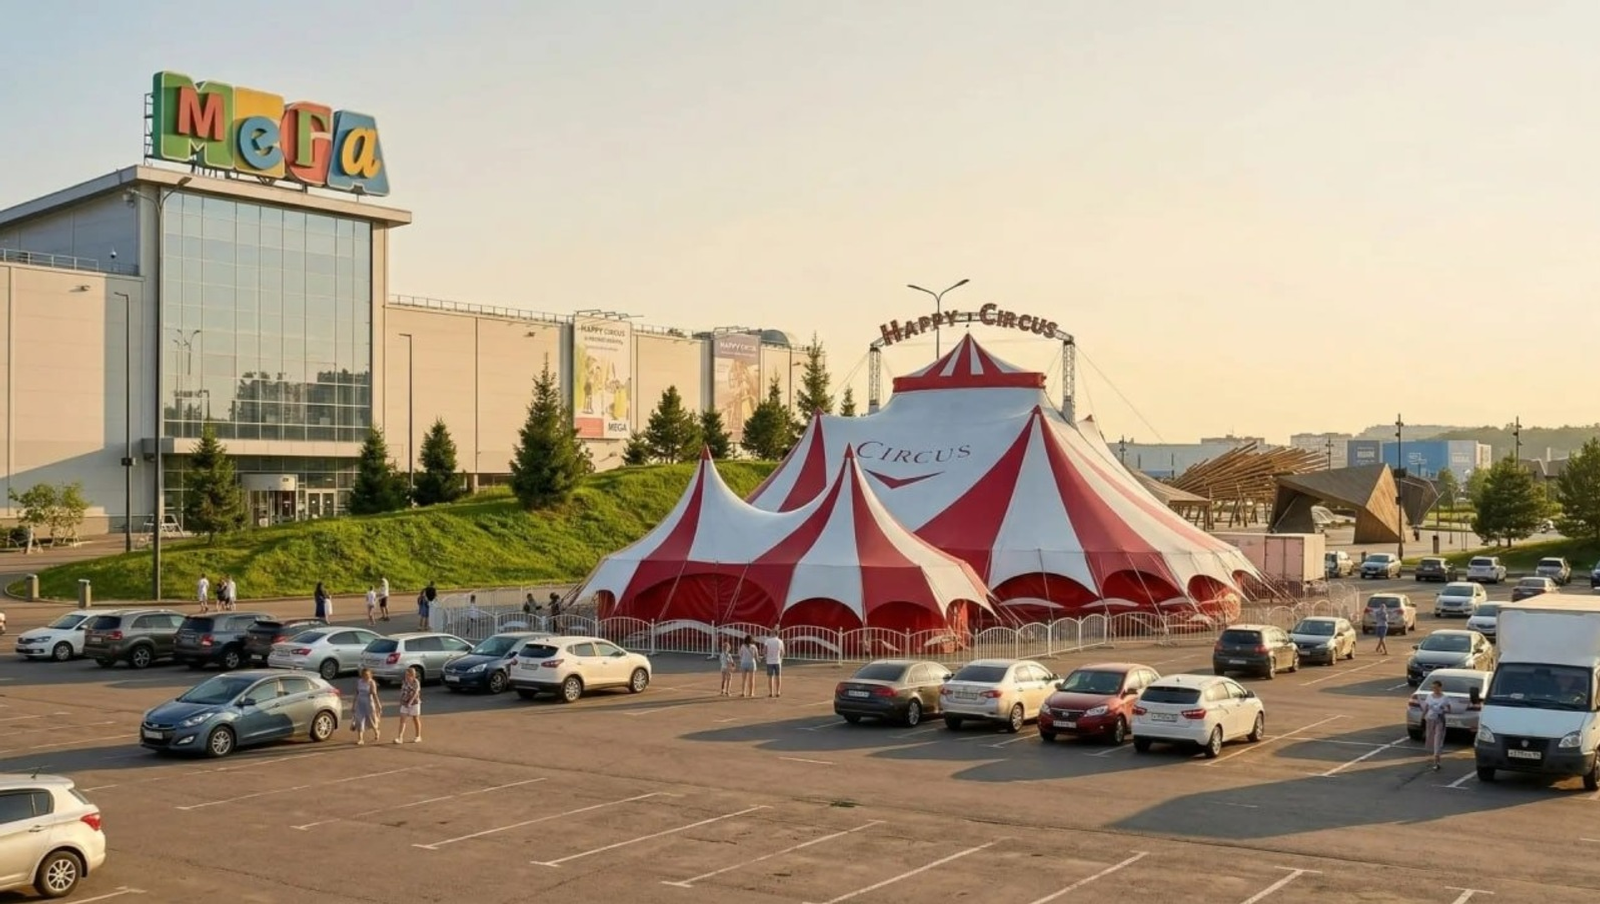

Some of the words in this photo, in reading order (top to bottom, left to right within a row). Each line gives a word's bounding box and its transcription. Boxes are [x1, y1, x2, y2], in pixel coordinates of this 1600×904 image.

[880, 309, 958, 346] HAPPY
[979, 303, 1058, 338] CIRCUS
[856, 441, 971, 464] CIRCUS
